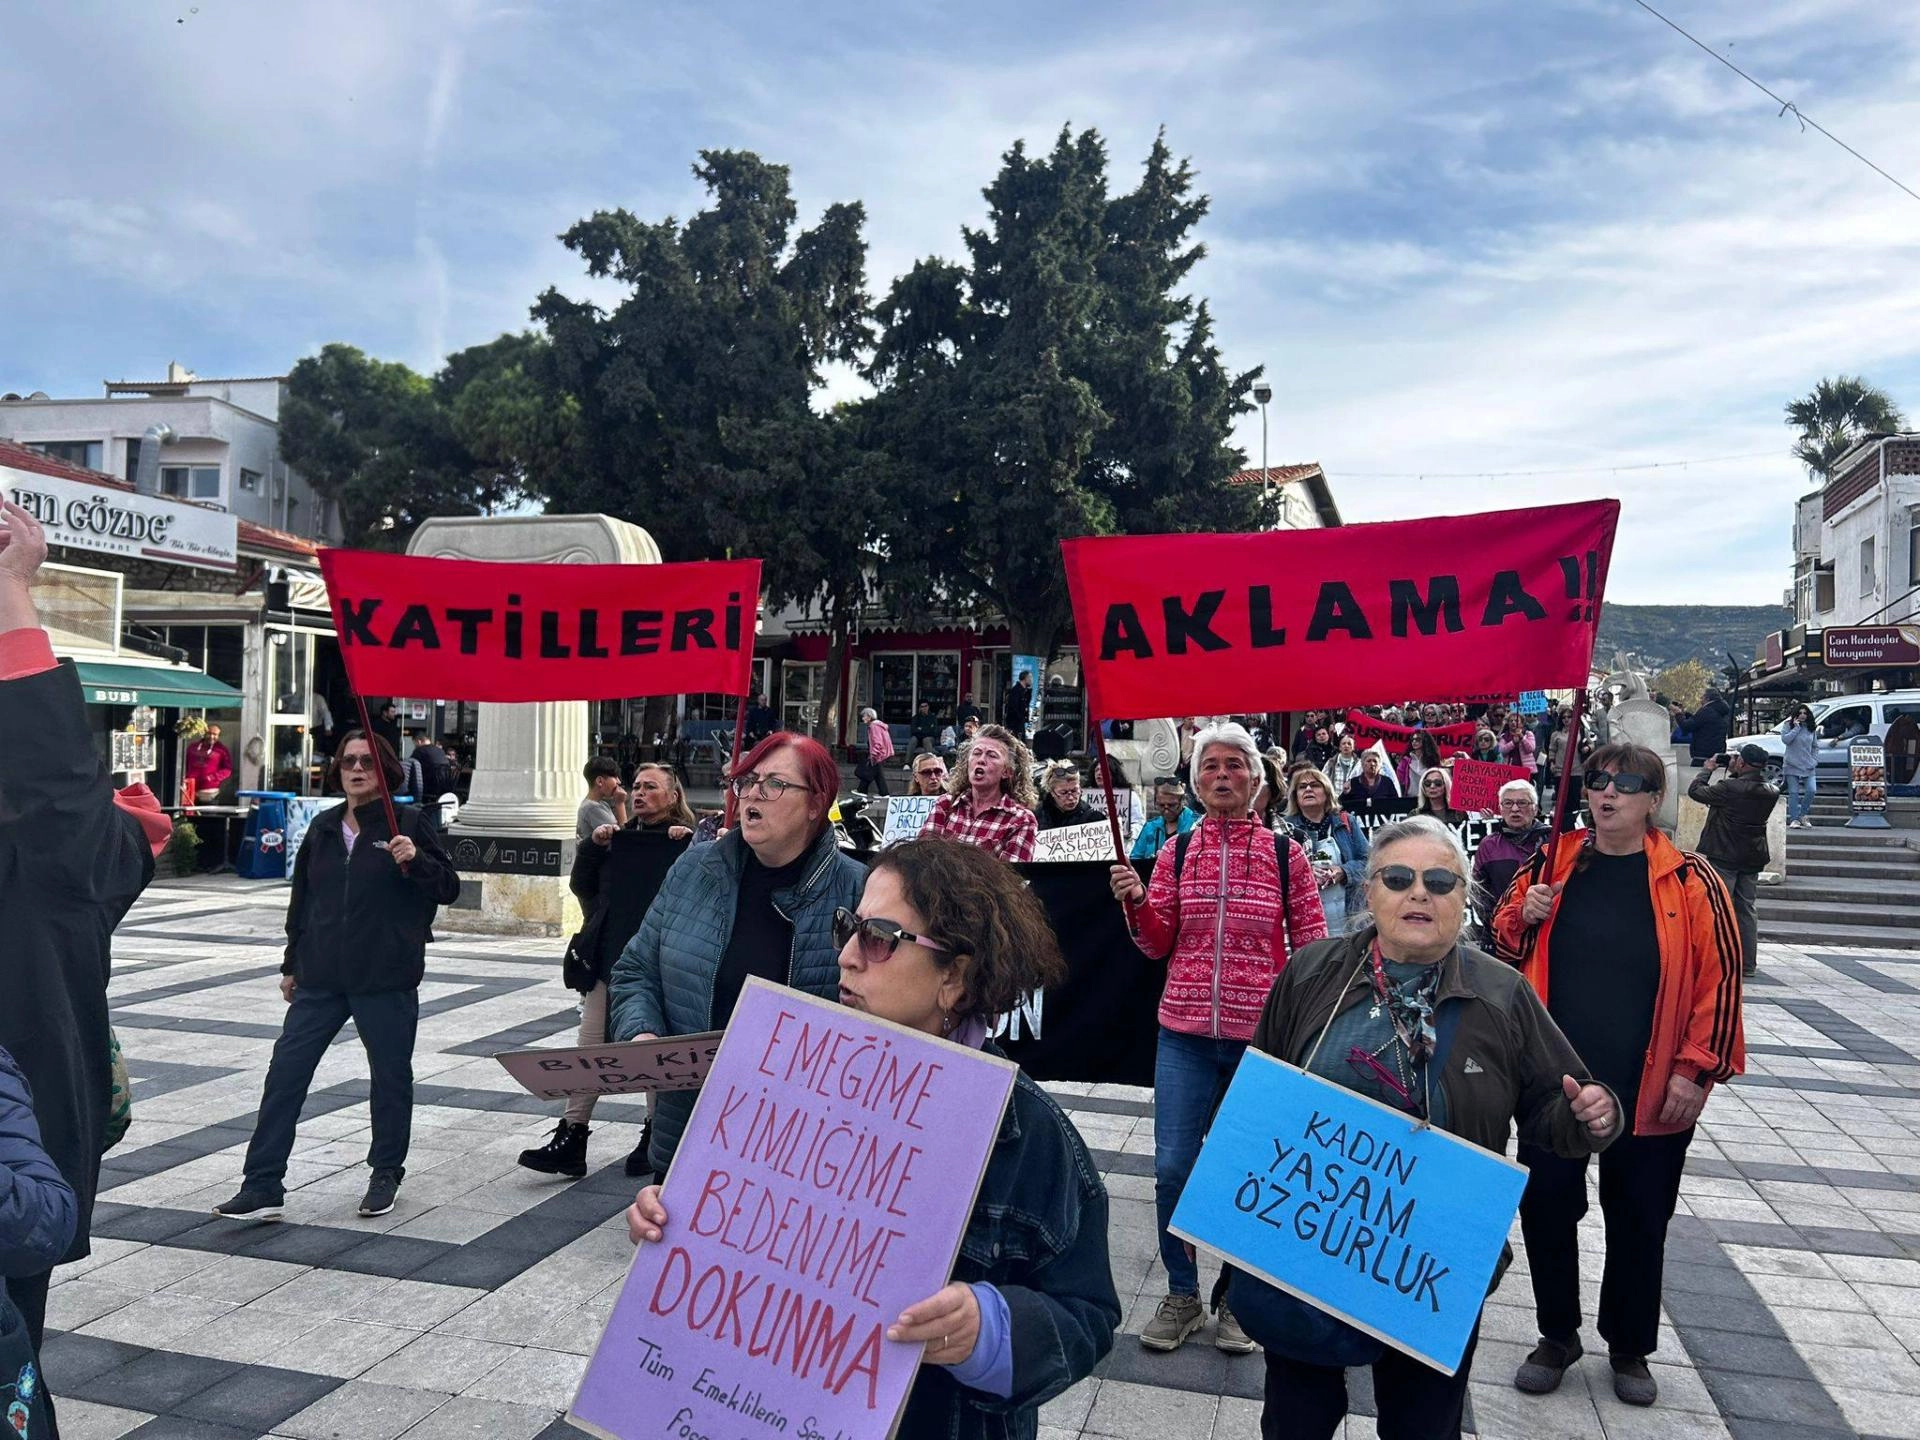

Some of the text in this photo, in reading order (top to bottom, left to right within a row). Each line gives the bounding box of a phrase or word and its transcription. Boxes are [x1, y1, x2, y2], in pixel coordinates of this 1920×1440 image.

[54, 532, 131, 552] Restaurant
[341, 591, 741, 659] KATİLLERİ
[1829, 634, 1848, 646] Can
[1829, 647, 1884, 661] Kuruyemiş
[1851, 746, 1883, 755] GEVREK
[1853, 754, 1882, 763] SARAYI
[1087, 794, 1123, 805] HAYTI
[599, 1070, 704, 1084] DAH
[757, 1010, 944, 1131] EMEĞİME
[710, 1084, 923, 1218] KİMLİĞİME
[1303, 1110, 1418, 1186] KADIN
[1268, 1138, 1416, 1239] YAŞAM
[688, 1168, 906, 1308] BEDENİME
[648, 1246, 883, 1410] DOKUNMA
[637, 1335, 675, 1382] Tüm
[691, 1367, 788, 1432] Emeklilerin
